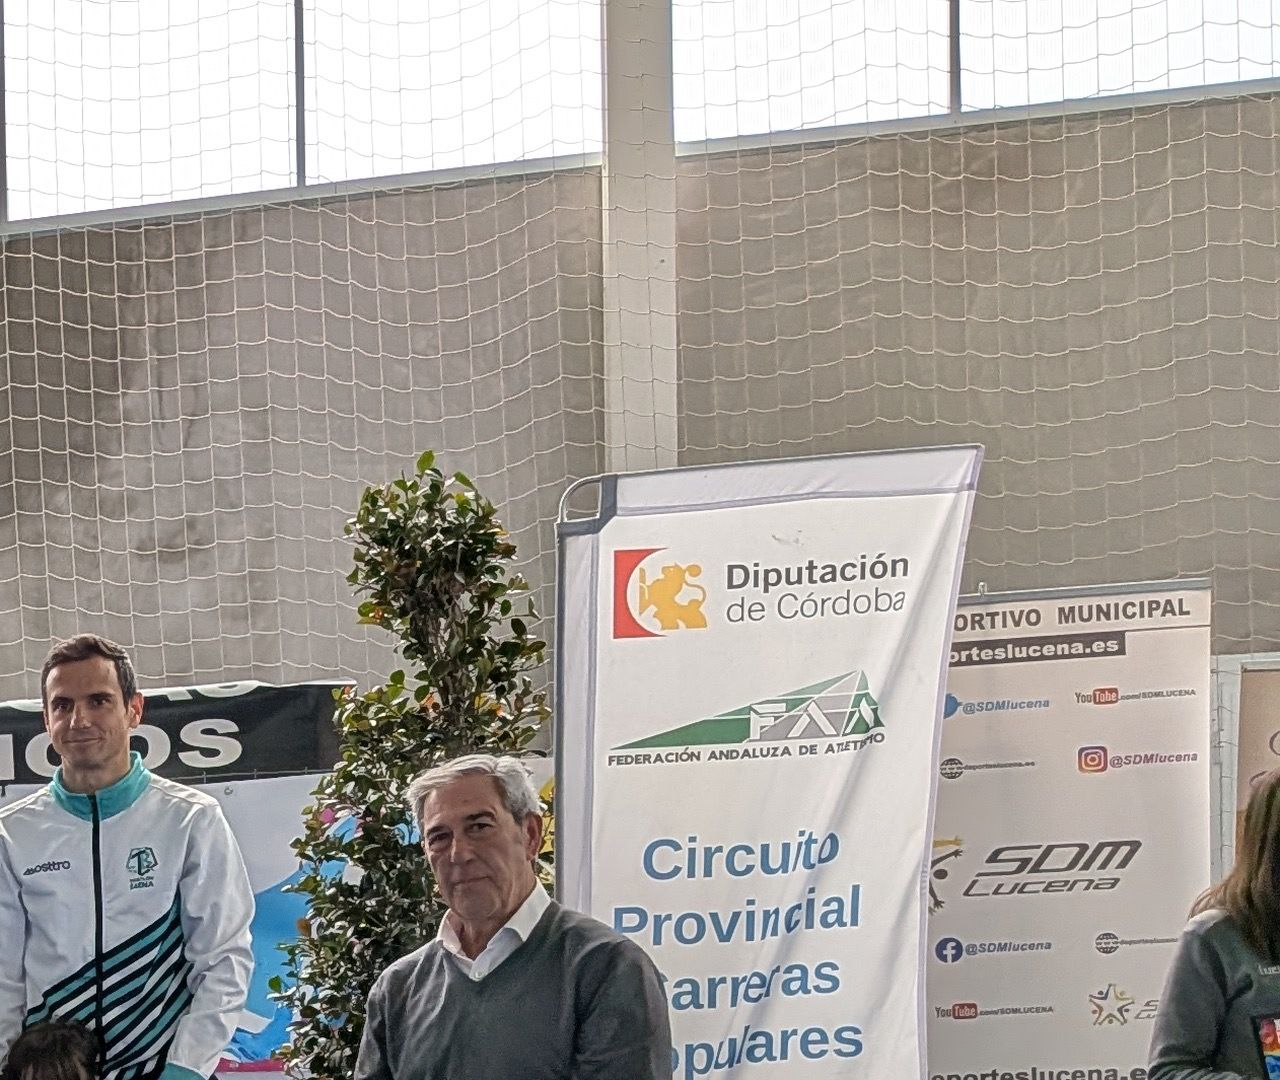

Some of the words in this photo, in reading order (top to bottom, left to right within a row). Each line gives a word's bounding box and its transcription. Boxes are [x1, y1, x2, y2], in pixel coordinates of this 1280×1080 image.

[726, 552, 909, 594] Diputación
[726, 593, 765, 623] de
[777, 587, 906, 620] Córdoba
[1057, 597, 1191, 626] MUNICIPAL
[962, 698, 1050, 715] @SDMlucena
[608, 747, 702, 767] FEDERACIÓN
[707, 746, 792, 763] ANDALUZA
[798, 743, 818, 757] DE
[1109, 751, 1199, 769] @SDMlucena
[642, 829, 841, 881] Circuito
[975, 840, 1142, 877] SDM
[962, 877, 1122, 898] Lucena
[613, 884, 861, 947] Provincial
[965, 940, 1052, 955] @SDMlucena
[662, 958, 841, 1011] arreras
